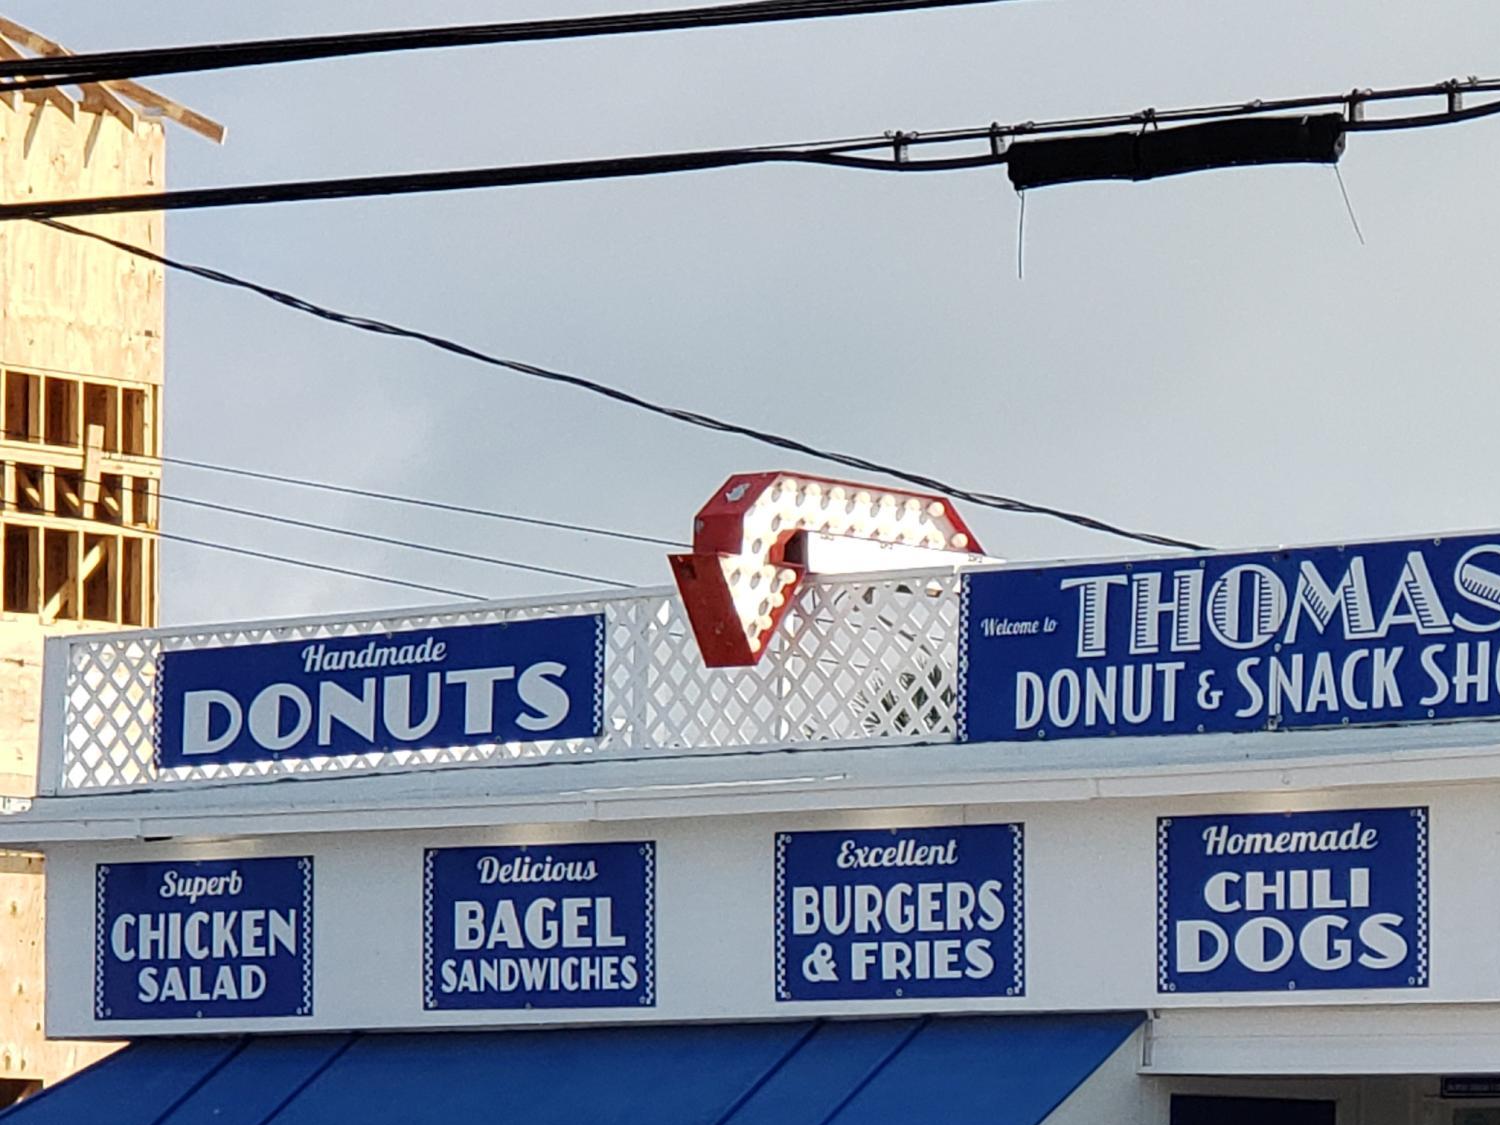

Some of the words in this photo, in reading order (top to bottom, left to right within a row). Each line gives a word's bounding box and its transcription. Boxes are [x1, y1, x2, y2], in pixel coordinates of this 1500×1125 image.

[981, 619, 1039, 636] Welcome
[1043, 617, 1057, 632] to
[302, 637, 445, 672] Handmade
[1016, 662, 1185, 729] DONUT
[1197, 670, 1223, 709] &
[1236, 647, 1403, 717] SNACK
[183, 662, 570, 755] DONUTS
[837, 840, 957, 868] Excellent
[1203, 823, 1377, 855] Homemade
[160, 870, 242, 903] Superb
[478, 856, 597, 883] Delicious
[793, 880, 1004, 935] BURGERS
[1205, 868, 1369, 912] CHILI
[112, 909, 296, 961] CHICKEN
[455, 897, 625, 949] BAGEL
[1177, 913, 1407, 972] DOGS
[442, 956, 637, 992] SANDWICHES
[803, 943, 838, 982] &
[852, 939, 993, 980] FRIES
[139, 965, 266, 1002] SALAD
